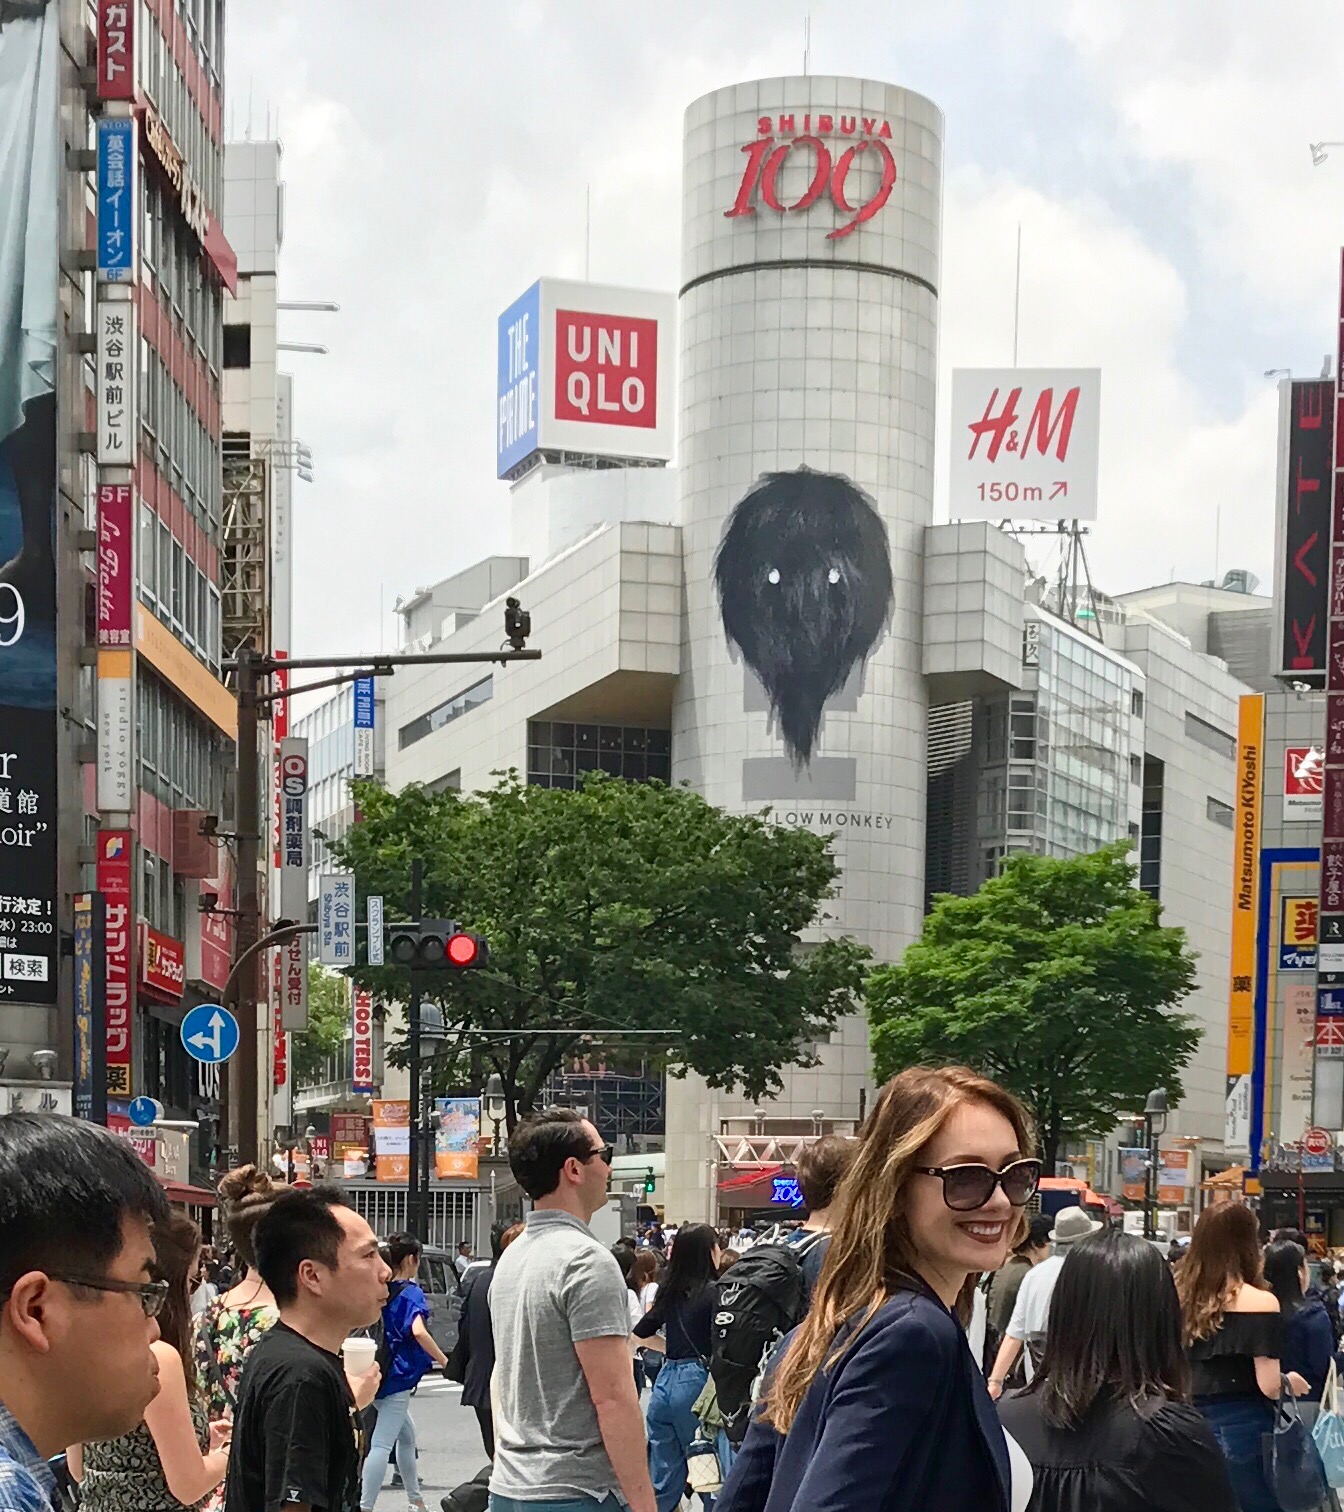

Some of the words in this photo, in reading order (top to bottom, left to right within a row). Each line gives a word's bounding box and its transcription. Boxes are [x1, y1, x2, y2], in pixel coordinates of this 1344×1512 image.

[106, 3, 127, 81] ガスト
[757, 115, 892, 139] SHIBUYA
[106, 135, 125, 265] 英会話イーオン
[724, 135, 897, 240] 109
[507, 312, 529, 372] THE
[567, 324, 638, 368] UNI
[105, 316, 124, 451] 渋谷駅前ビル
[567, 370, 645, 416] QLO
[499, 369, 537, 453] PRIME
[968, 386, 1080, 464] H&M
[101, 486, 129, 503] 5F
[99, 629, 130, 644] 美容室
[357, 678, 371, 697] THE
[357, 698, 371, 726] PRIME
[283, 755, 306, 796] OS
[286, 799, 303, 867] 調剤薬局
[820, 813, 893, 829] MONKEY
[1238, 811, 1254, 910] Matsumoto
[21, 920, 52, 934] 23:00
[323, 893, 332, 928] Shibuya
[333, 882, 350, 958] 渋谷駅前
[9, 957, 43, 978] 検索
[106, 903, 127, 1052] サンドラッグ
[287, 919, 301, 1006] 方せん受付
[107, 1064, 126, 1092] 薬
